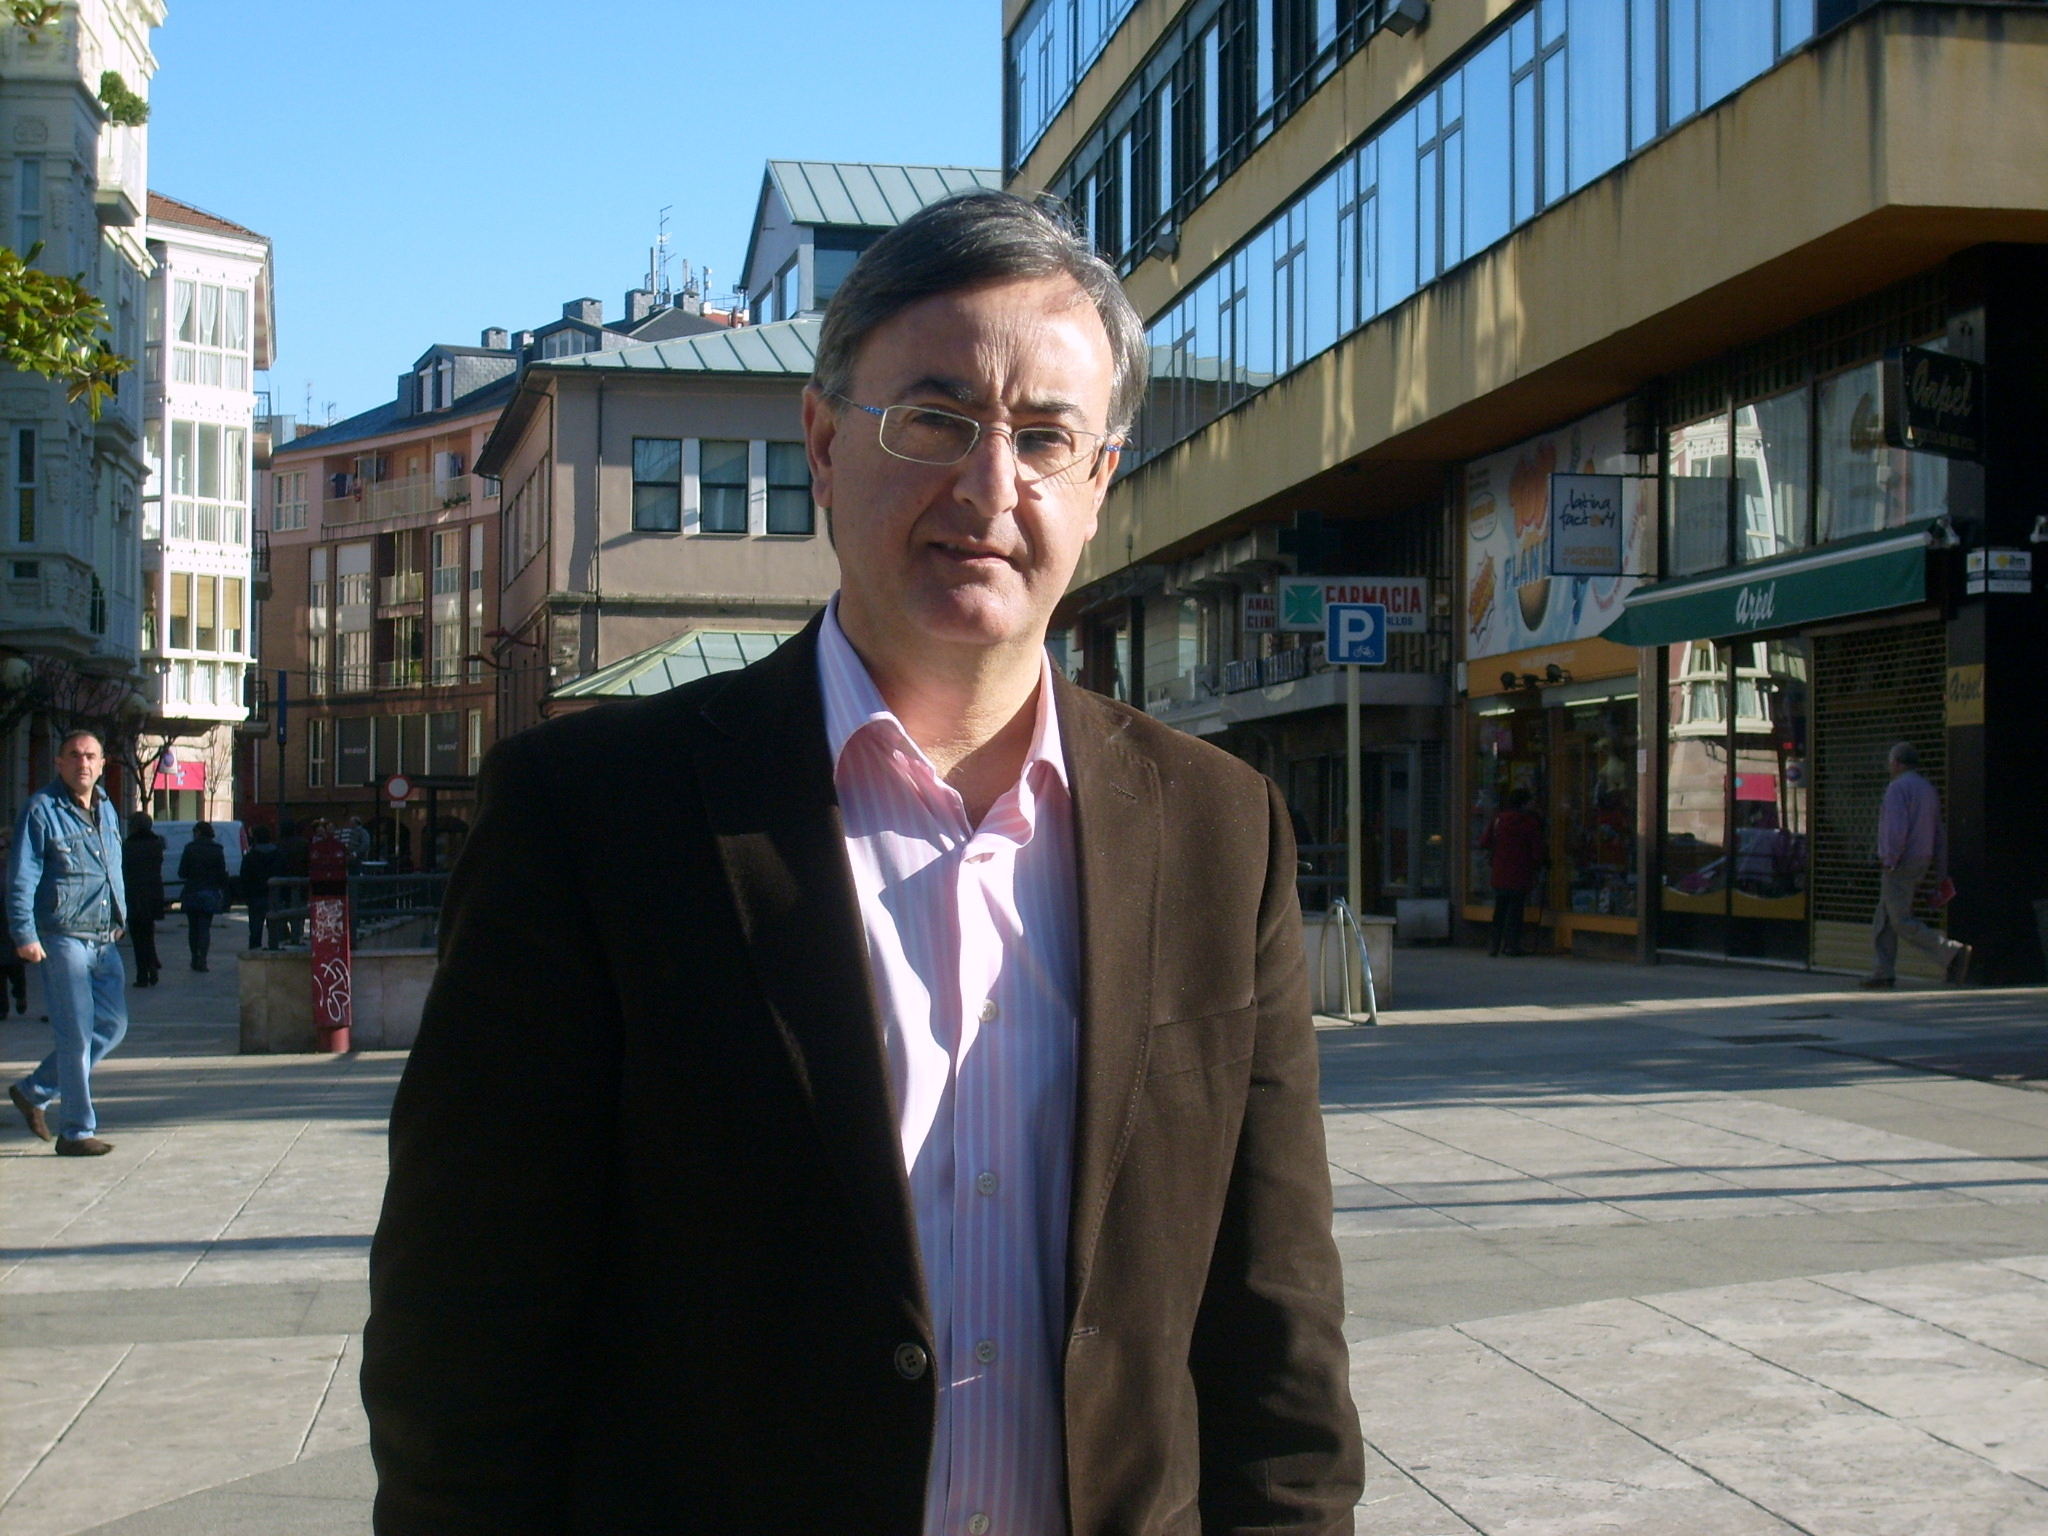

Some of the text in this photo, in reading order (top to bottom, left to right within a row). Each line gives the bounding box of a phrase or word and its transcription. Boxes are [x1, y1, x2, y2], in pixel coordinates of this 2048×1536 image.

[1569, 488, 1611, 511] latina
[1559, 503, 1616, 531] factory
[1325, 585, 1422, 613] FARMACIA
[1338, 608, 1375, 658] P
